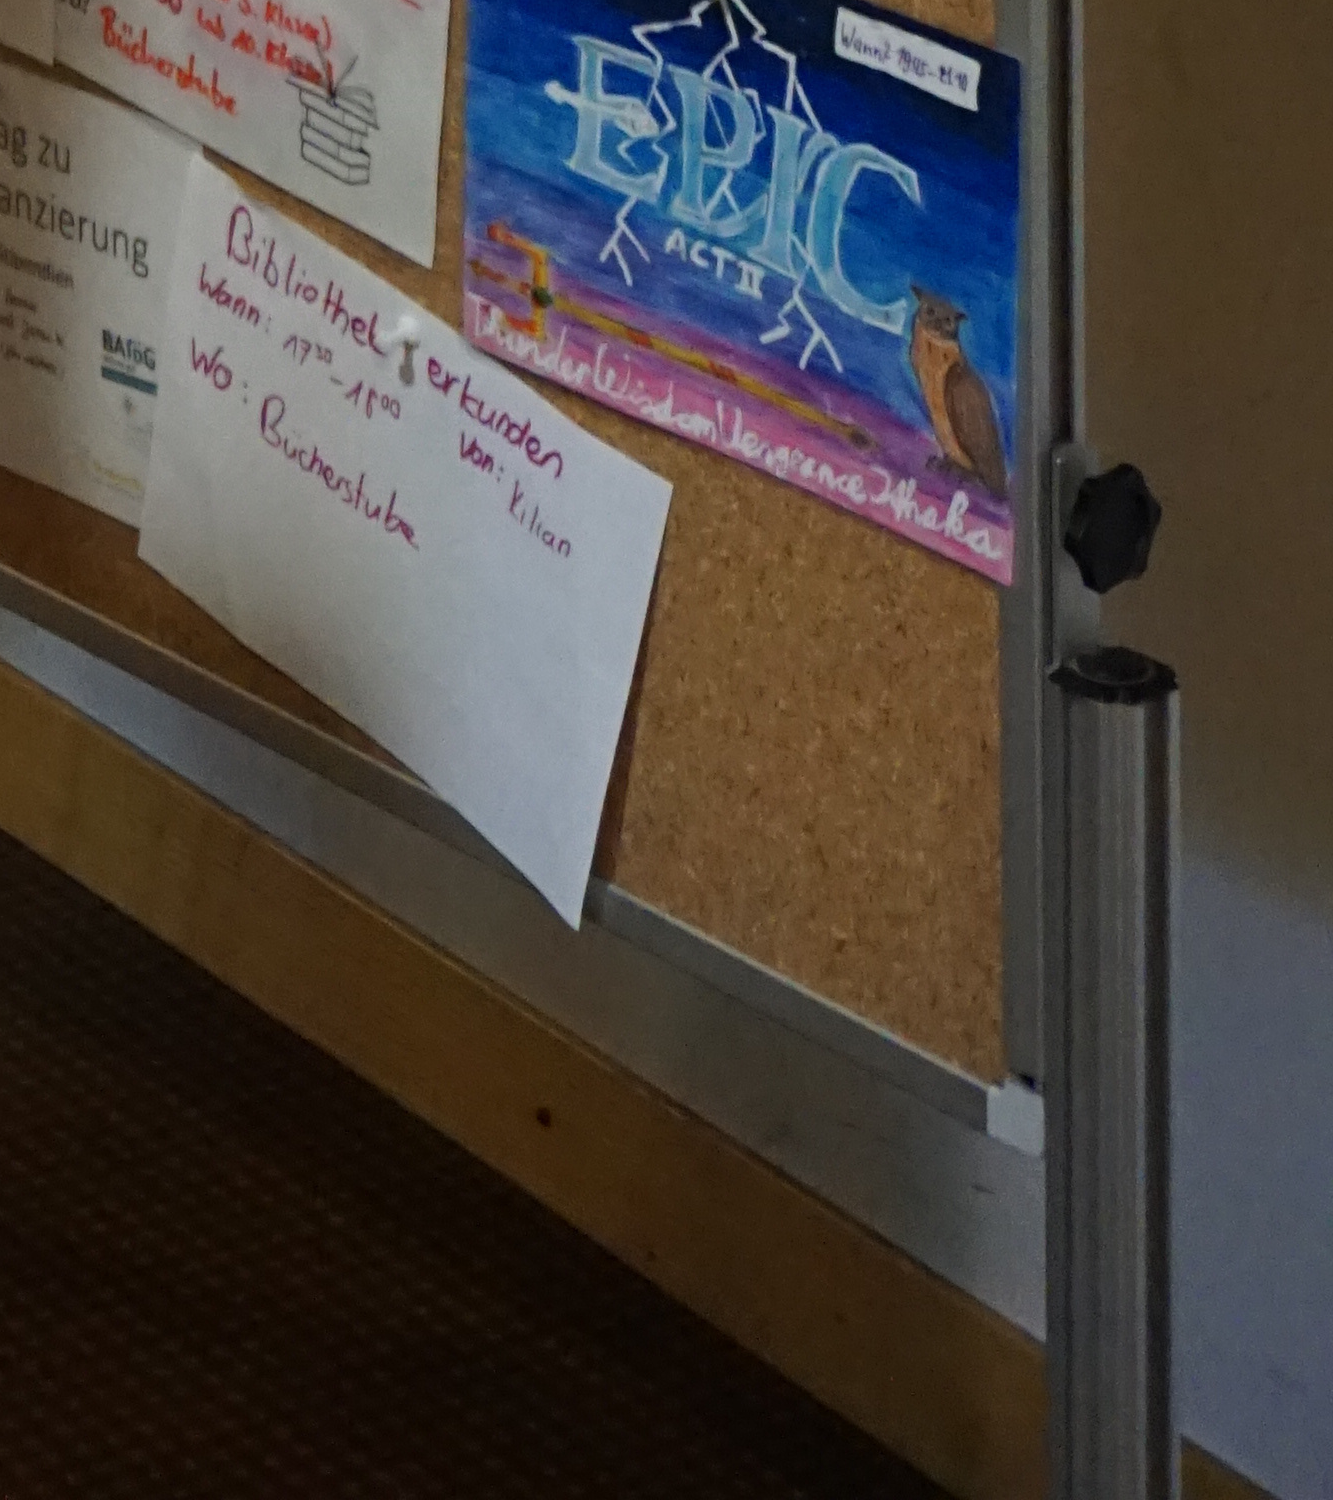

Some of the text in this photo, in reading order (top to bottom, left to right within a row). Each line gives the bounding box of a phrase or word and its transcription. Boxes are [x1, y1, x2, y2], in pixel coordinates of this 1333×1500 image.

[36, 133, 72, 177] zu
[543, 32, 927, 338] EPIC
[663, 226, 734, 292] ACT
[198, 264, 272, 338] Wann:
[190, 336, 421, 553] Wo: Bücherstube
[424, 358, 566, 481] erkunden
[506, 481, 574, 559] Kilian
